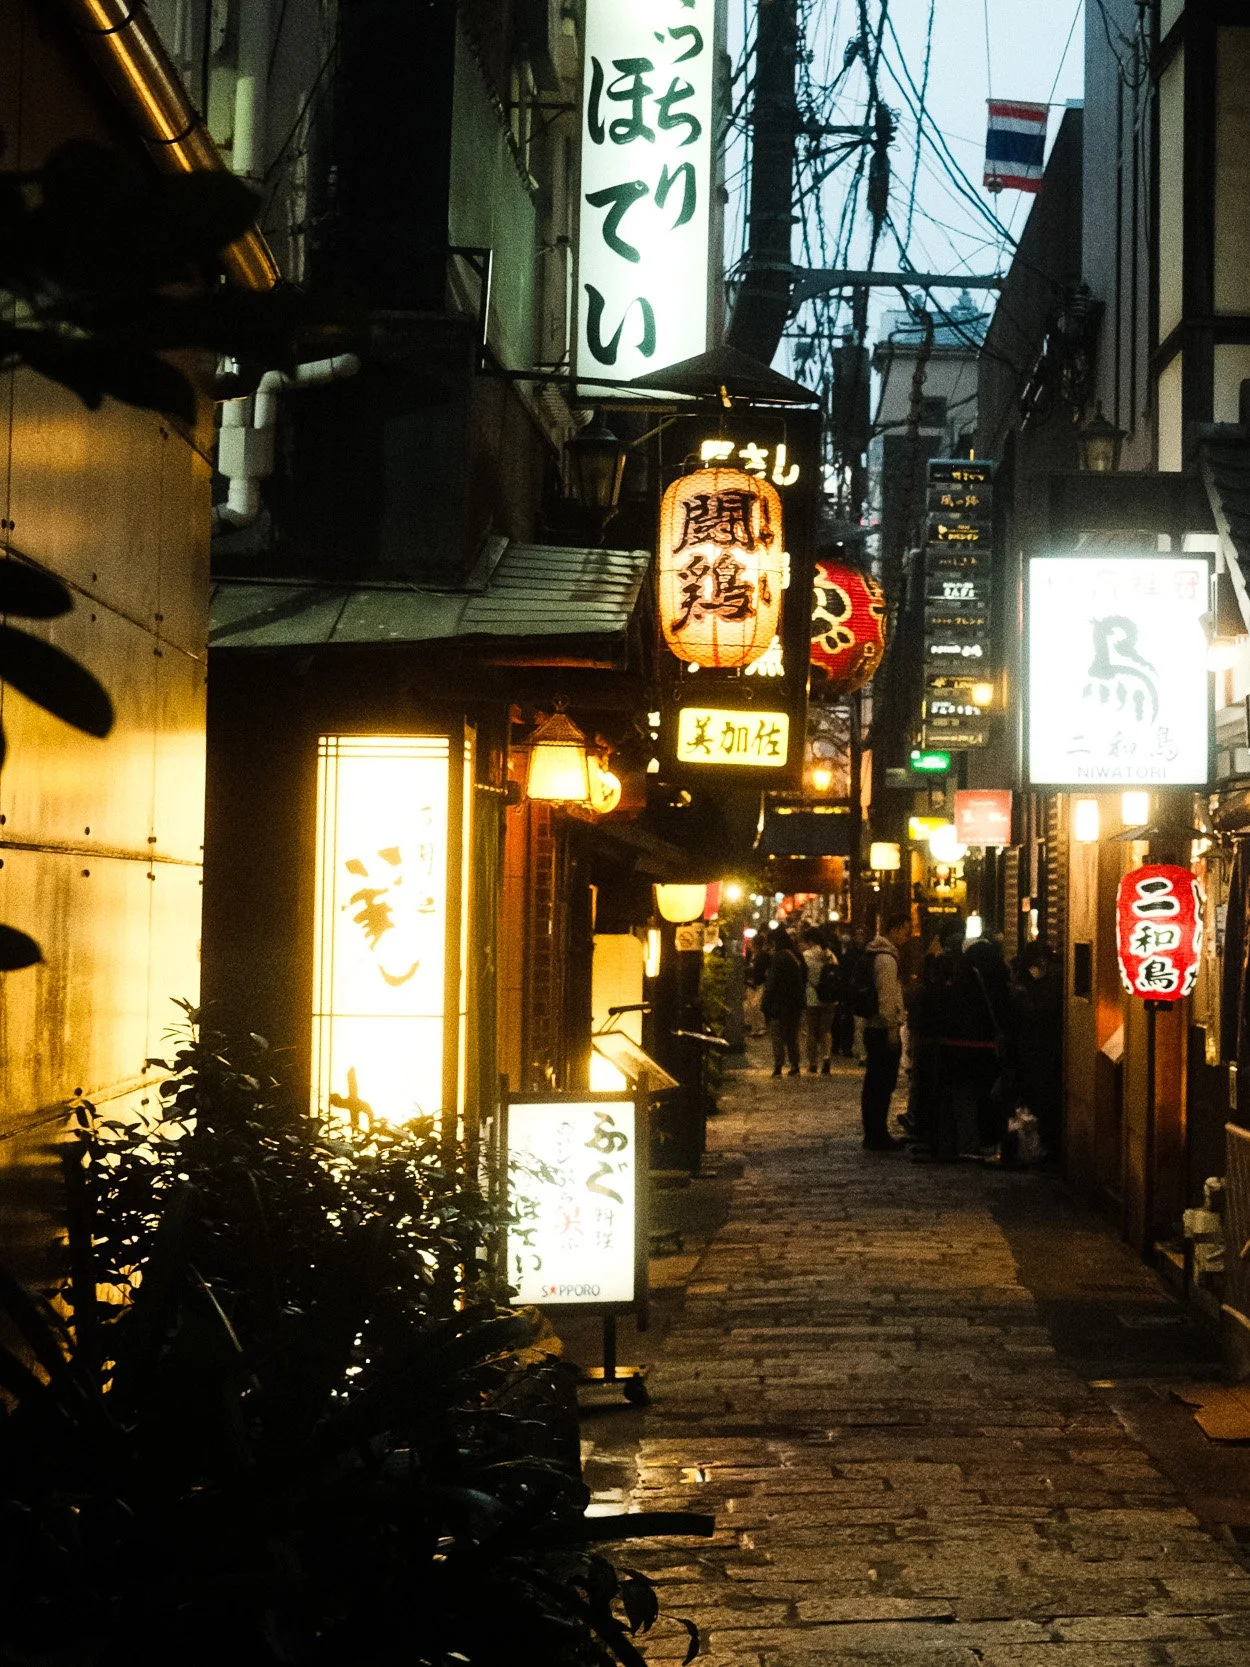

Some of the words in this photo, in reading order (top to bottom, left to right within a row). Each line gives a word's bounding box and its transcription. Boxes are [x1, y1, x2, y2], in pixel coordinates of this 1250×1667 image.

[584, 55, 657, 366] ほてい
[685, 715, 781, 757] 美加佐
[1077, 766, 1167, 778] NIWATORI
[1133, 879, 1178, 991] 二和鳥
